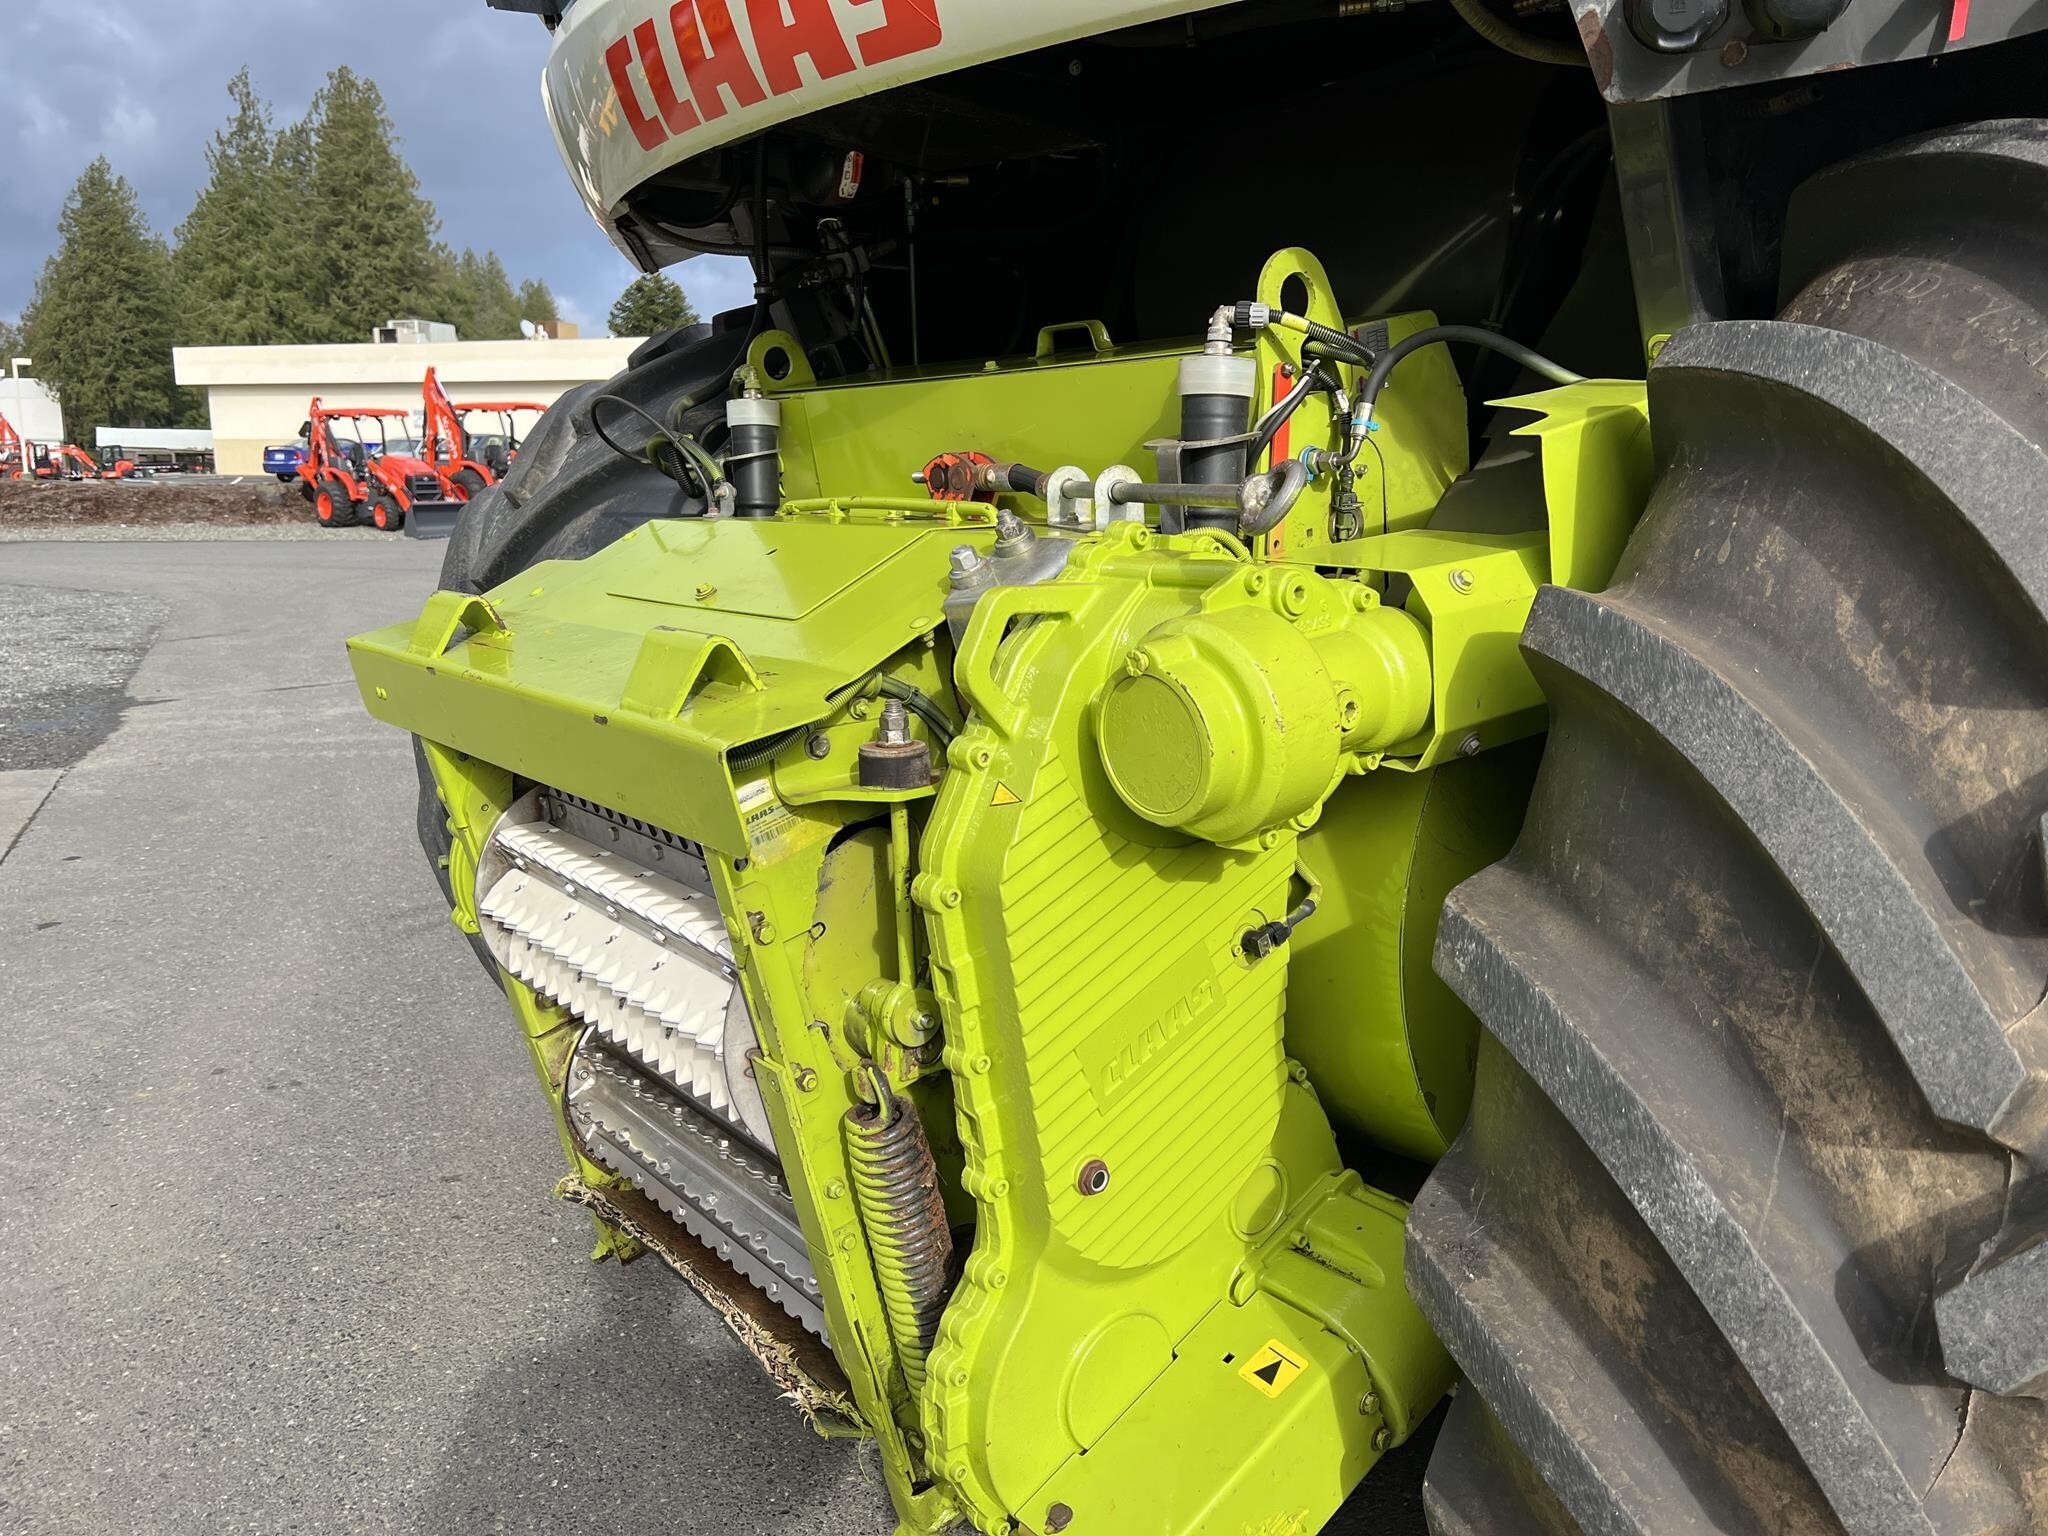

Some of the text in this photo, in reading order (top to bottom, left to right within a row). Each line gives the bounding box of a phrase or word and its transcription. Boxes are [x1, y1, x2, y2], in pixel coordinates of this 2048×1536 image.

[605, 0, 942, 152] CLAAS
[745, 805, 775, 825] LAAS
[1101, 978, 1214, 1097] CLAAS
